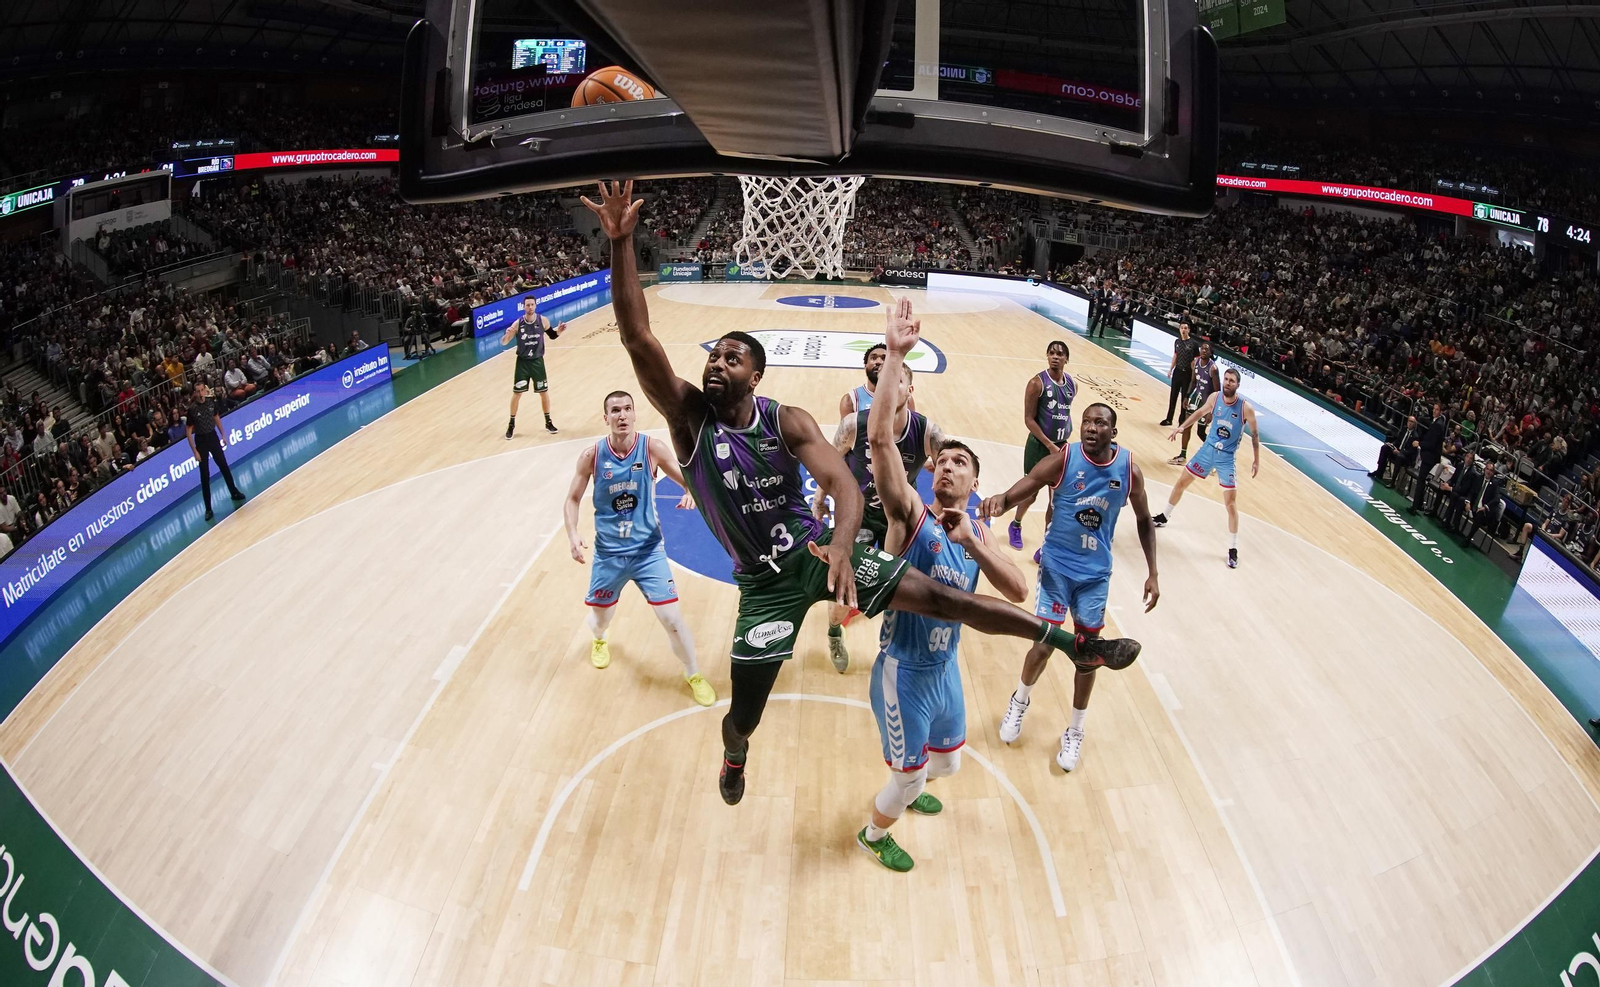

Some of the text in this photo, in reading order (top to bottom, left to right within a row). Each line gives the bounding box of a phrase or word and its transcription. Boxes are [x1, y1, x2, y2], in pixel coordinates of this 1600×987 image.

[1253, 4, 1268, 16] 2024
[1211, 18, 1224, 29] 2024
[503, 99, 544, 113] endesa
[504, 94, 522, 104] liga
[272, 151, 377, 164] www.grupotrocadero.com
[17, 188, 53, 208] UNICAJA
[1321, 185, 1433, 207] www.grupotrocadero.com
[1489, 208, 1521, 225] UNICAJA
[1537, 216, 1550, 233] 78
[1566, 225, 1591, 244] 4:24
[885, 269, 926, 279] endesa
[528, 349, 534, 357] 4
[353, 356, 388, 377] instituto hm
[1057, 427, 1065, 441] 11
[2, 547, 67, 609] Matricúlate
[68, 532, 85, 553] en
[86, 497, 135, 540] nuestros
[136, 473, 169, 504] ciclos
[229, 429, 243, 446] de
[244, 412, 272, 441] grado
[274, 393, 310, 419] superior
[618, 521, 633, 539] 17
[770, 522, 794, 552] 3
[1081, 533, 1098, 551] 18
[928, 627, 952, 652] 99
